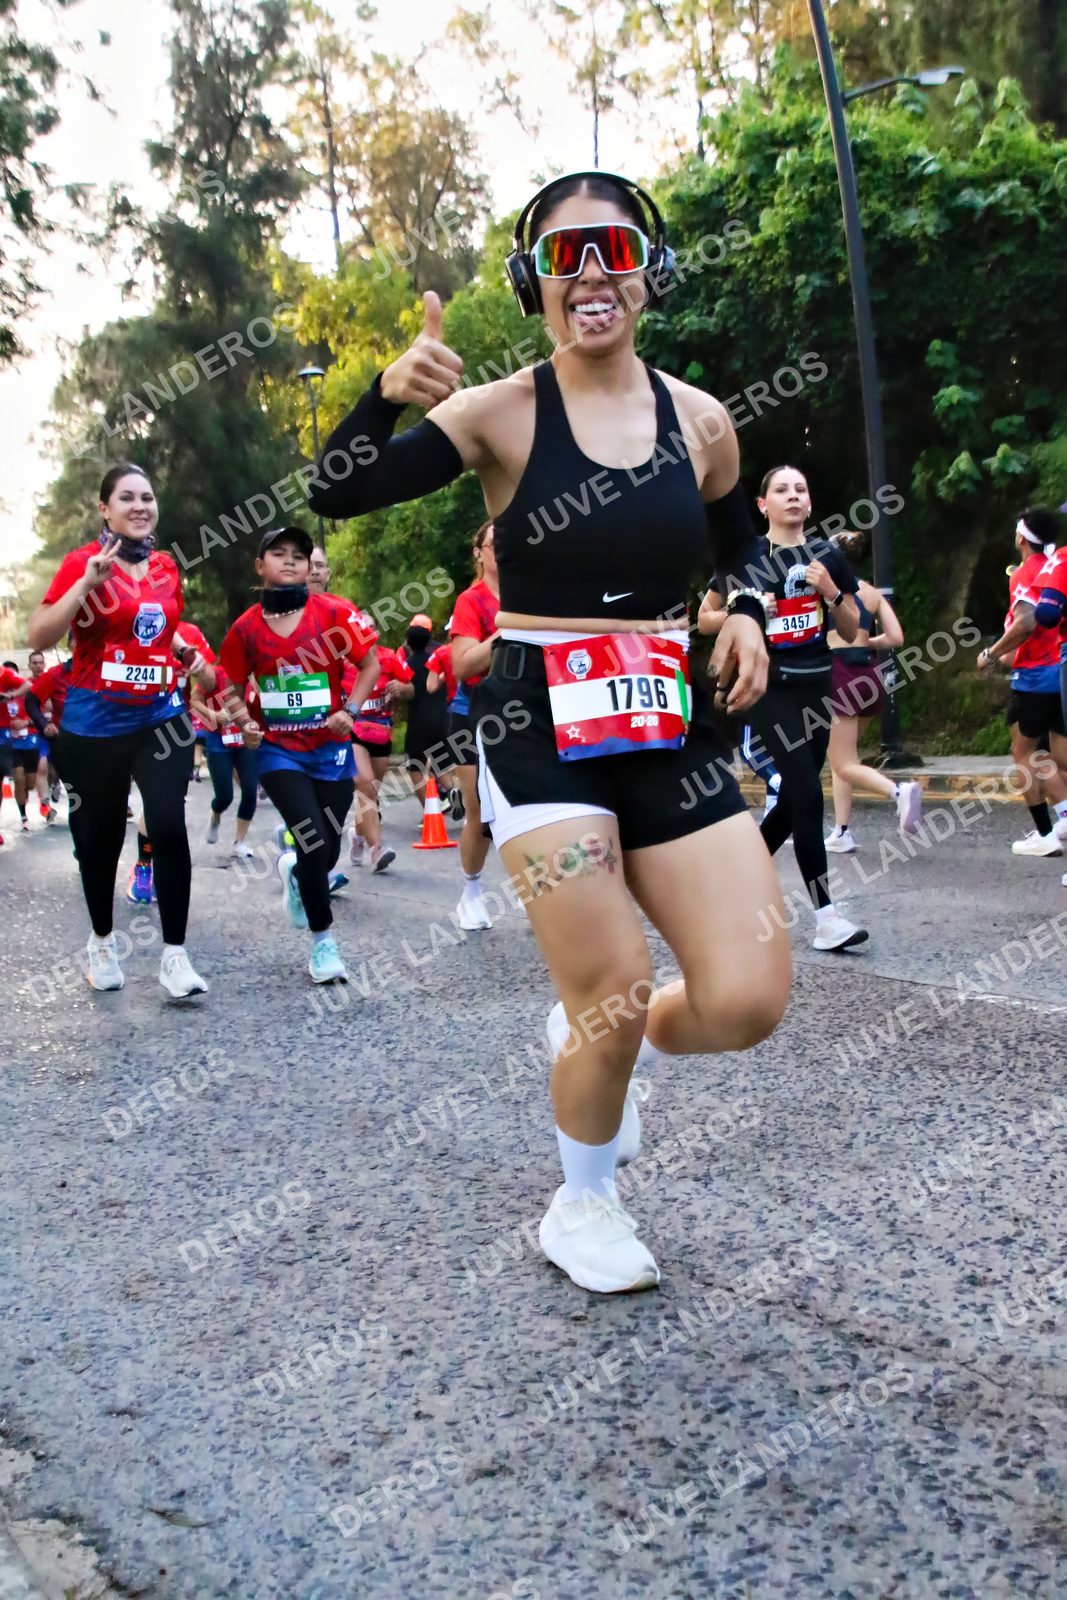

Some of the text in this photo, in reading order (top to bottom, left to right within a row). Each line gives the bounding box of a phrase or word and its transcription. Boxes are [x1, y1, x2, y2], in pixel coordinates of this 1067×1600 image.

[782, 614, 810, 632] 3457
[126, 667, 155, 682] 2244
[287, 693, 303, 707] 69
[607, 677, 668, 712] 1796
